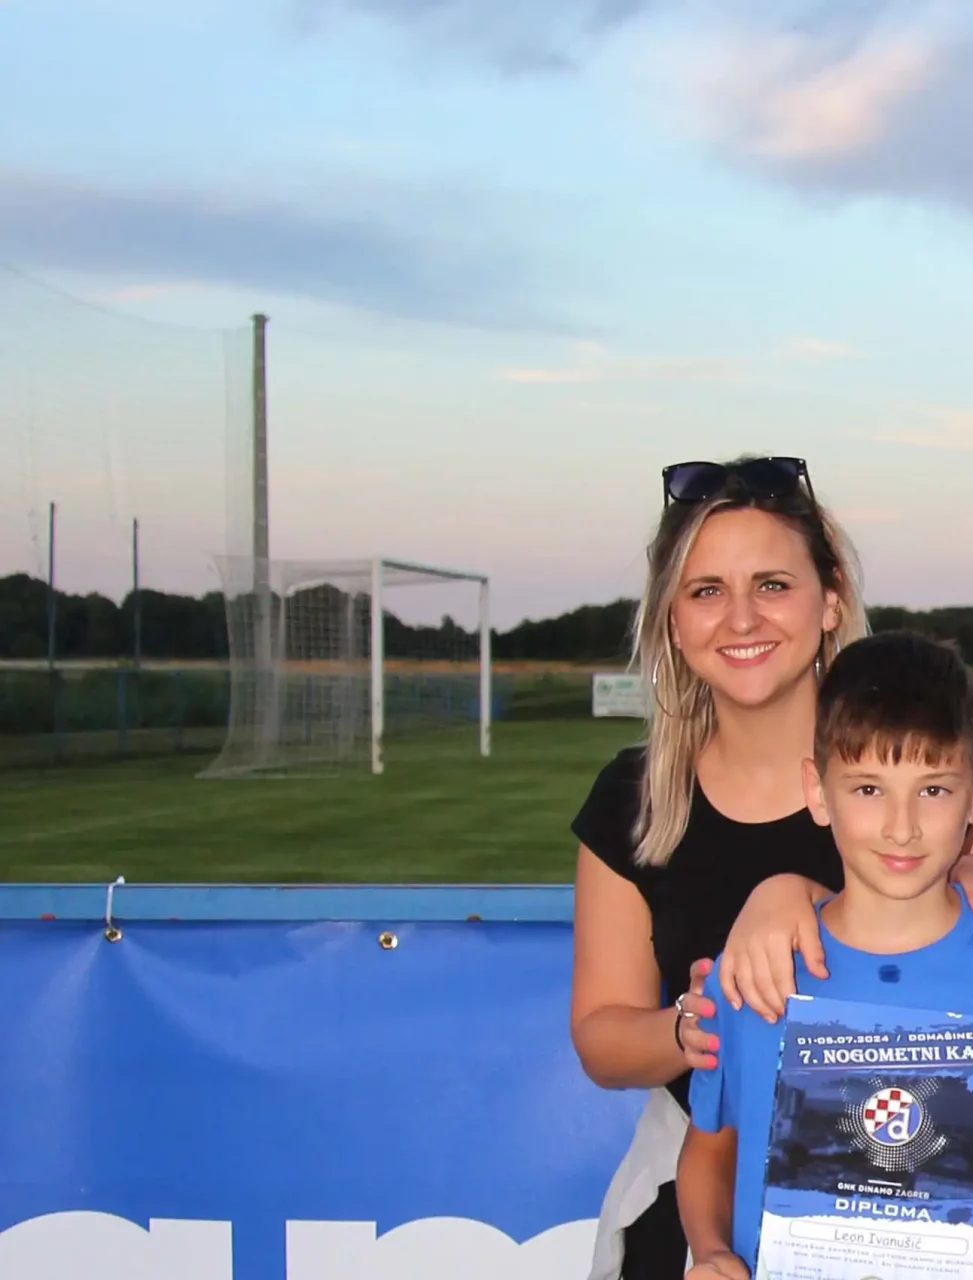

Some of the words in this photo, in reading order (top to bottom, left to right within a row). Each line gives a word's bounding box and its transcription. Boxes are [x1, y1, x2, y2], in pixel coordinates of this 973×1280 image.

[799, 1050, 818, 1064] 7.
[823, 1047, 941, 1064] NOGOMETNI
[837, 1182, 856, 1192] GNK
[858, 1185, 893, 1196] DINAMO
[895, 1189, 930, 1200] ZAGREB
[835, 1198, 931, 1220] DIPLOMA
[834, 1229, 864, 1243] Leon
